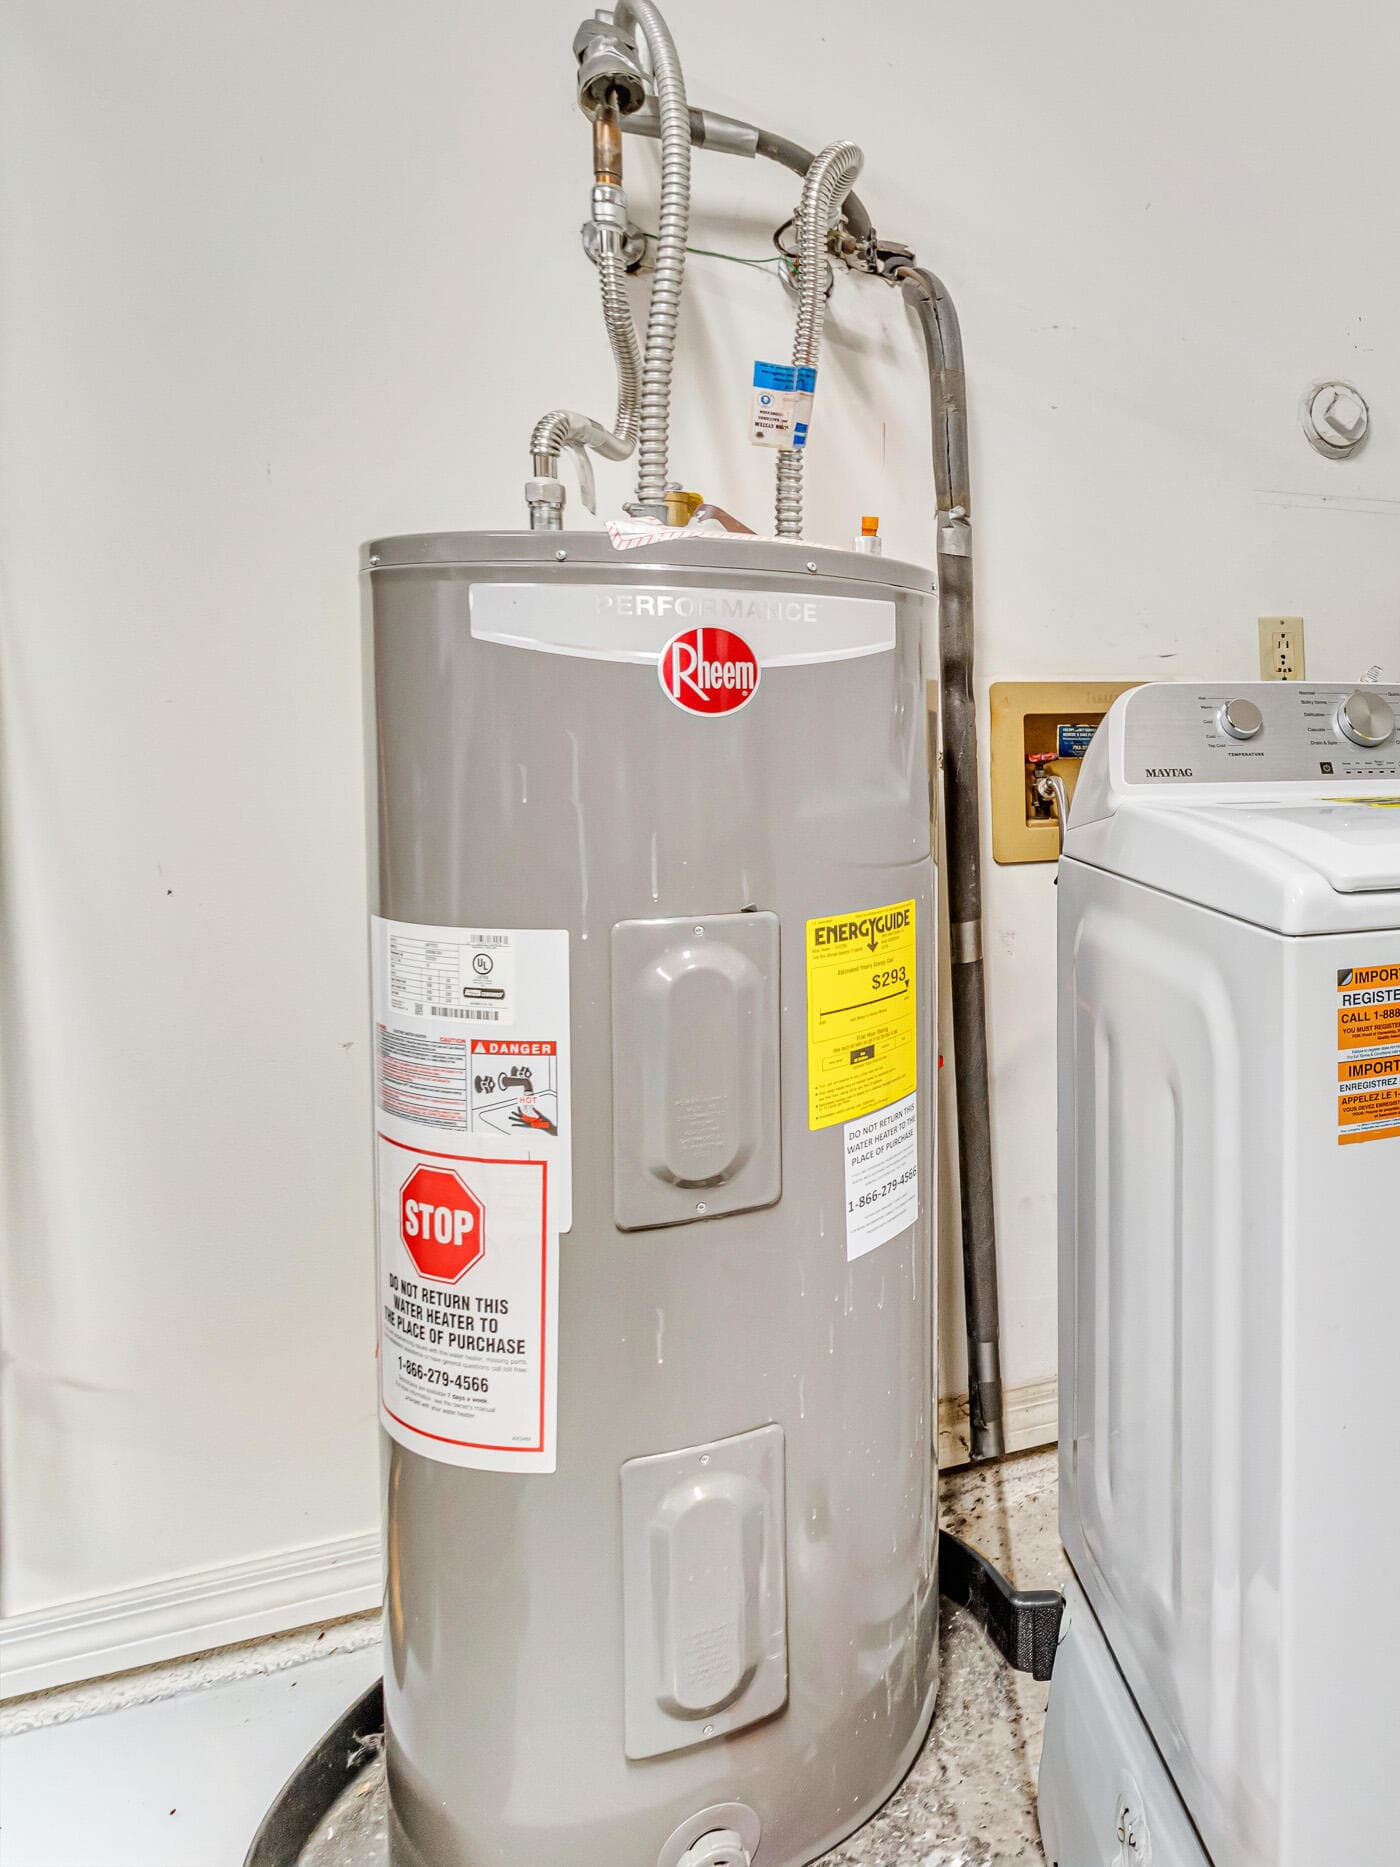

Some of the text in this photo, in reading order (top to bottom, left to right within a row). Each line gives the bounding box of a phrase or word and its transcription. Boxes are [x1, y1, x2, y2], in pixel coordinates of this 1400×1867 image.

[595, 596, 818, 623] PERFORMANCE
[672, 628, 754, 701] Rheem
[1145, 768, 1193, 778] MAYTAG
[814, 909, 910, 948] ENERGYGUIDE
[872, 966, 907, 992] $293
[1341, 1012, 1371, 1024] CALL
[1342, 1026, 1356, 1034] YOU
[1356, 1025, 1373, 1033] MUST
[439, 1036, 466, 1044] CAUTION
[489, 1042, 551, 1054] DANGER
[519, 1096, 537, 1104] HOT
[1339, 1077, 1398, 1092] ENREGISTREZ
[1341, 1093, 1380, 1105] APPELEZ
[1381, 1091, 1392, 1099] LE
[847, 1137, 873, 1155] WATER
[874, 1125, 898, 1143] HEATER
[898, 1120, 906, 1130] TO
[849, 1103, 915, 1141] DO NOT RETURN THIS
[851, 1129, 914, 1167] PLACE OF PURCHASE
[848, 1166, 917, 1213] 1-866-279-4566
[404, 1198, 475, 1247] STOP
[388, 1272, 509, 1315] DO NOT RETURN THIS
[384, 1305, 396, 1327] THE
[397, 1316, 426, 1341] PLACE
[429, 1326, 445, 1345] OF
[448, 1333, 526, 1355] PURCHASE
[393, 1294, 498, 1334] WATER HEATER TO
[398, 1356, 489, 1393] 1-866-279-4566
